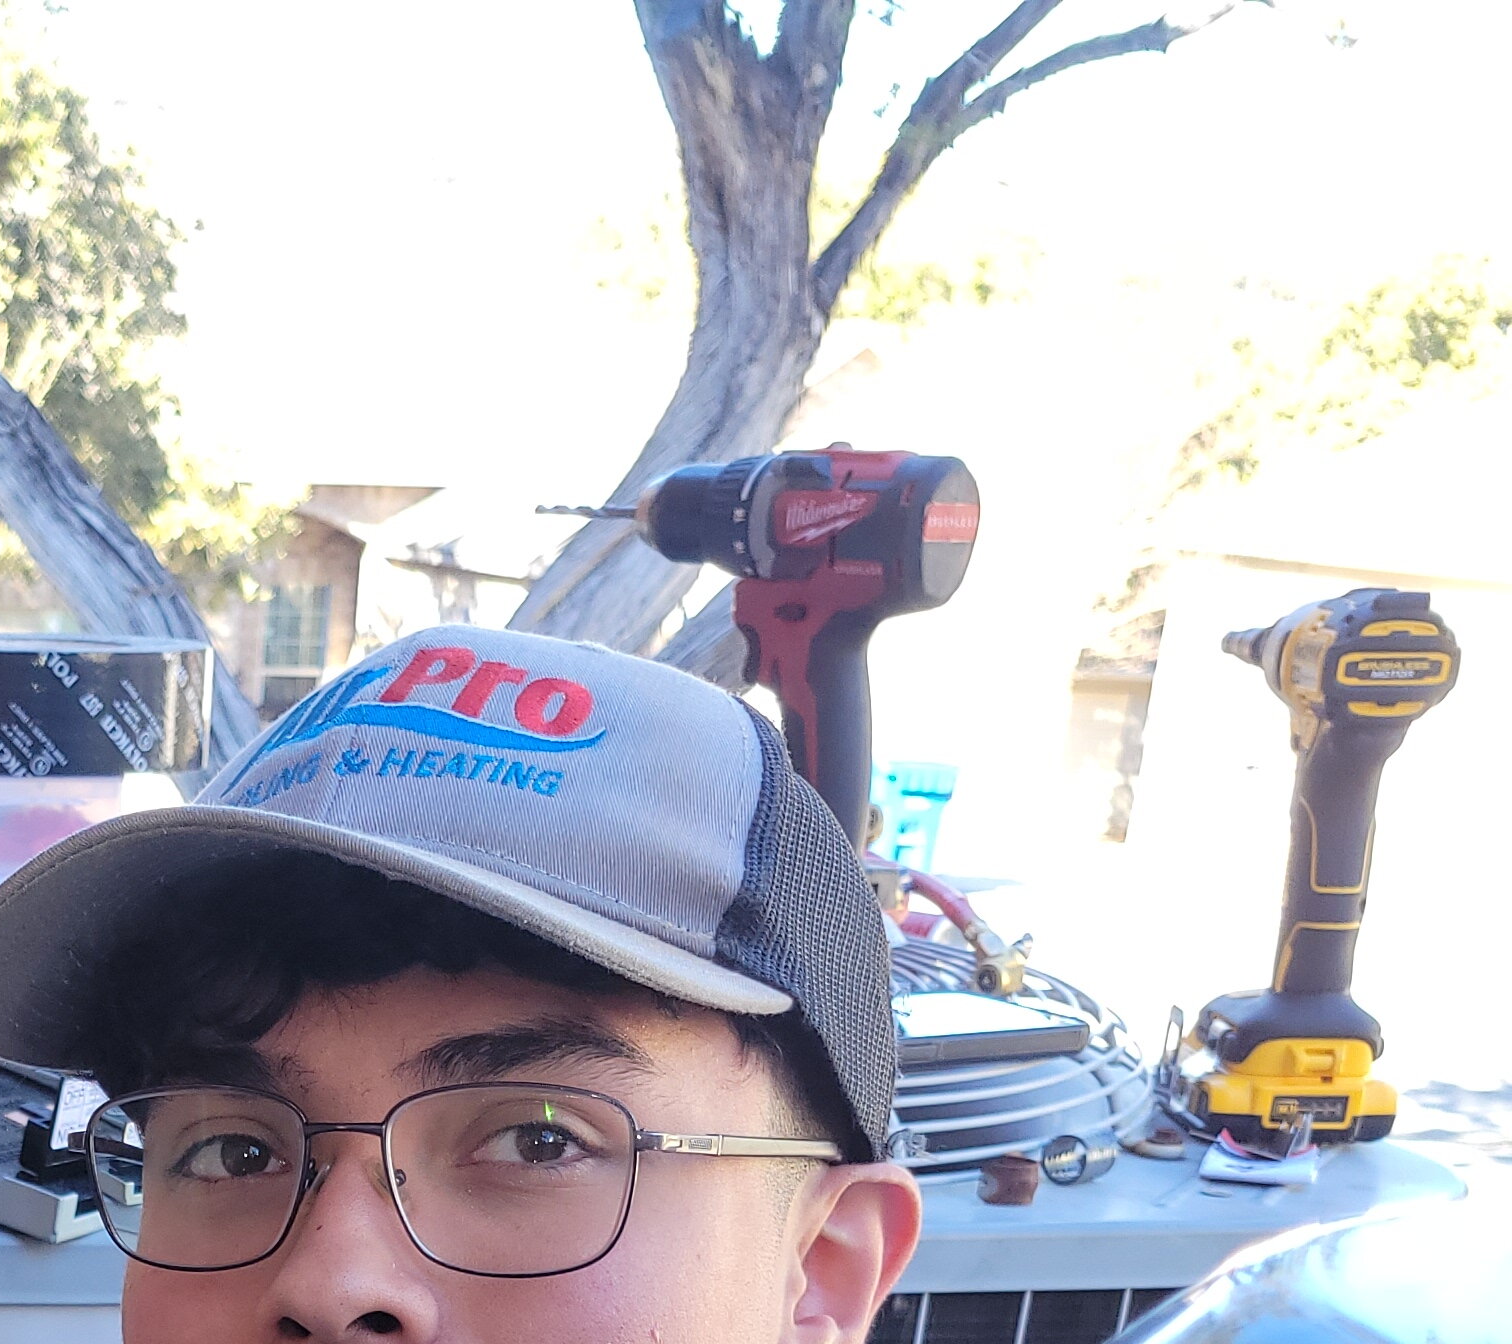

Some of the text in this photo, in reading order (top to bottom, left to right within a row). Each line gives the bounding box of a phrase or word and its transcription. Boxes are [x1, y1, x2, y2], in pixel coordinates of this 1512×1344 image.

[98, 713, 149, 773] OLYKEN
[333, 747, 371, 777] &
[378, 749, 565, 798] HEATING
